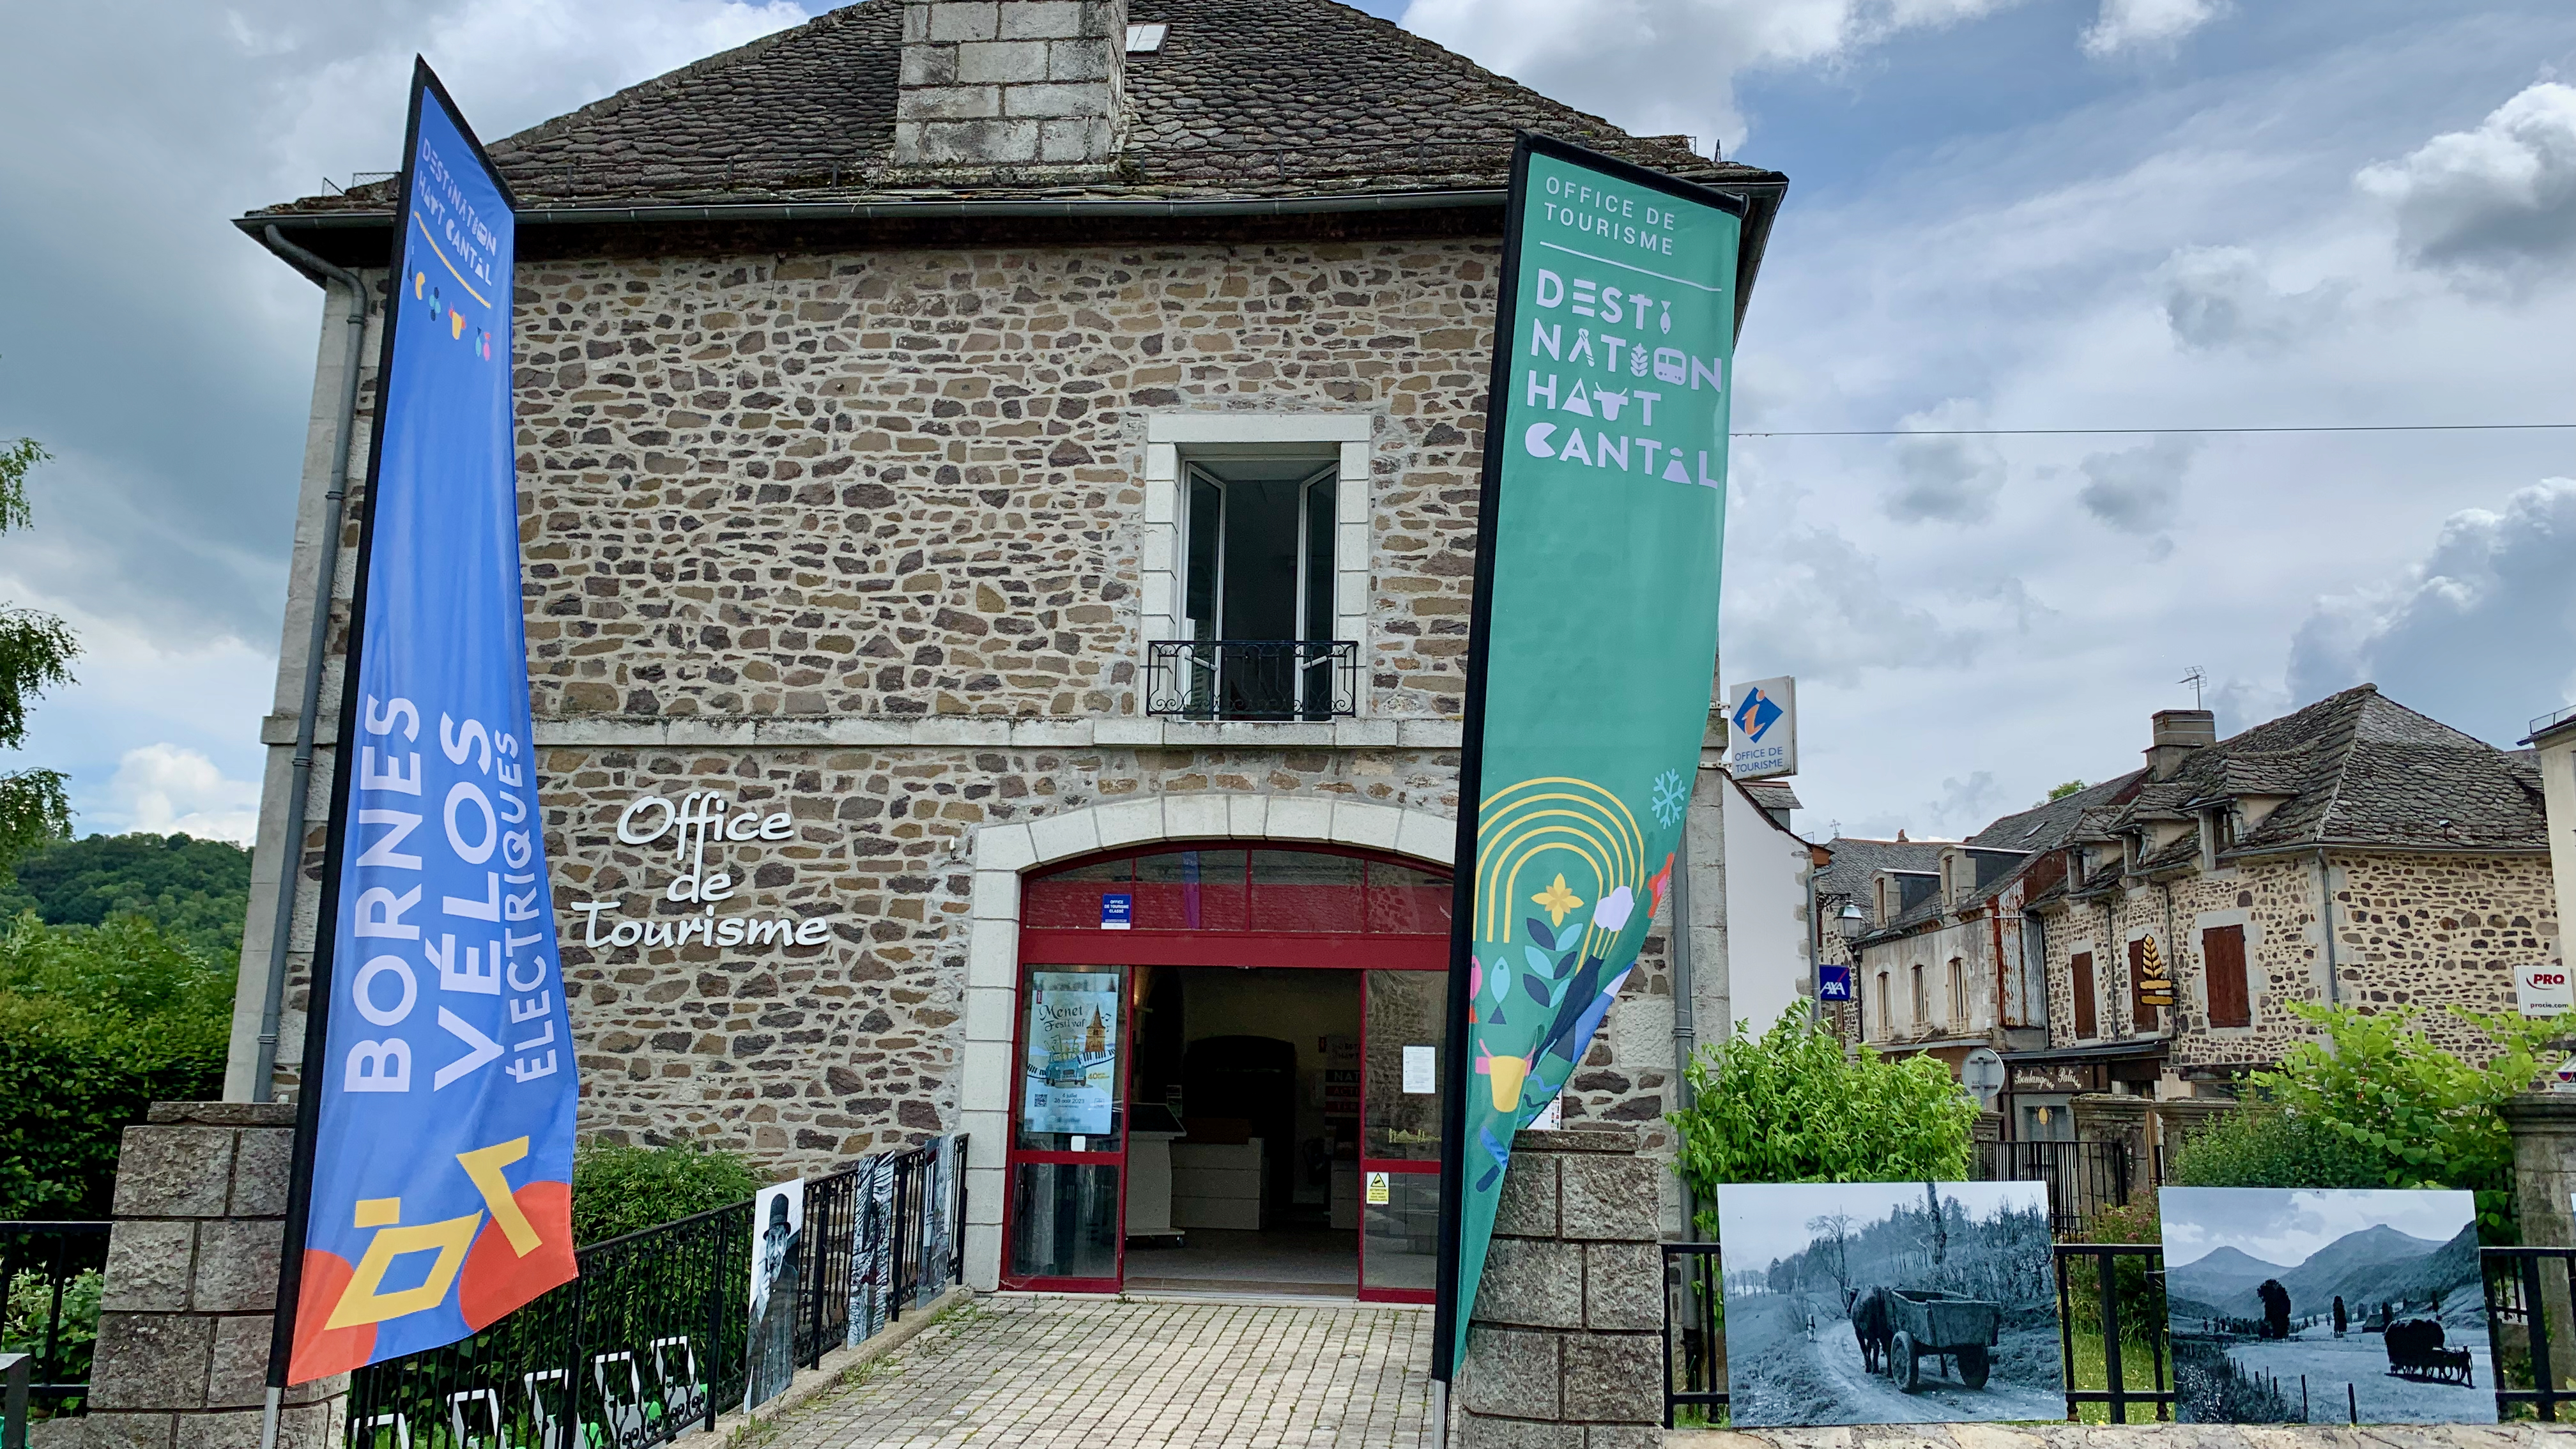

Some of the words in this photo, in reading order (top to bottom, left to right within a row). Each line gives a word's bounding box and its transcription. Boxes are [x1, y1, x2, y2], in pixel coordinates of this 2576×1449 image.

[1545, 176, 1635, 218] OFFICE
[1646, 206, 1676, 231] DE
[1544, 201, 1673, 256] TOURISME
[1524, 422, 1719, 489] CANTAL
[1734, 748, 1765, 762] OFFICE
[1768, 746, 1783, 756] DE
[1735, 758, 1783, 773] TOURISME
[617, 790, 795, 861] Office
[343, 693, 424, 1093] BORNES
[424, 710, 505, 1092] VÉLOS
[666, 869, 735, 905] de
[494, 729, 558, 1084] ÉLECTRIQUES
[570, 899, 831, 949] Tourisme
[1820, 981, 1846, 996] AXA
[2533, 974, 2565, 985] PRO
[1039, 1004, 1083, 1021] Menet
[1043, 1018, 1085, 1032] Festival
[1334, 1071, 1360, 1082] NAT
[2014, 1069, 2055, 1091] Boulangerie
[1333, 1087, 1358, 1096] ACTI
